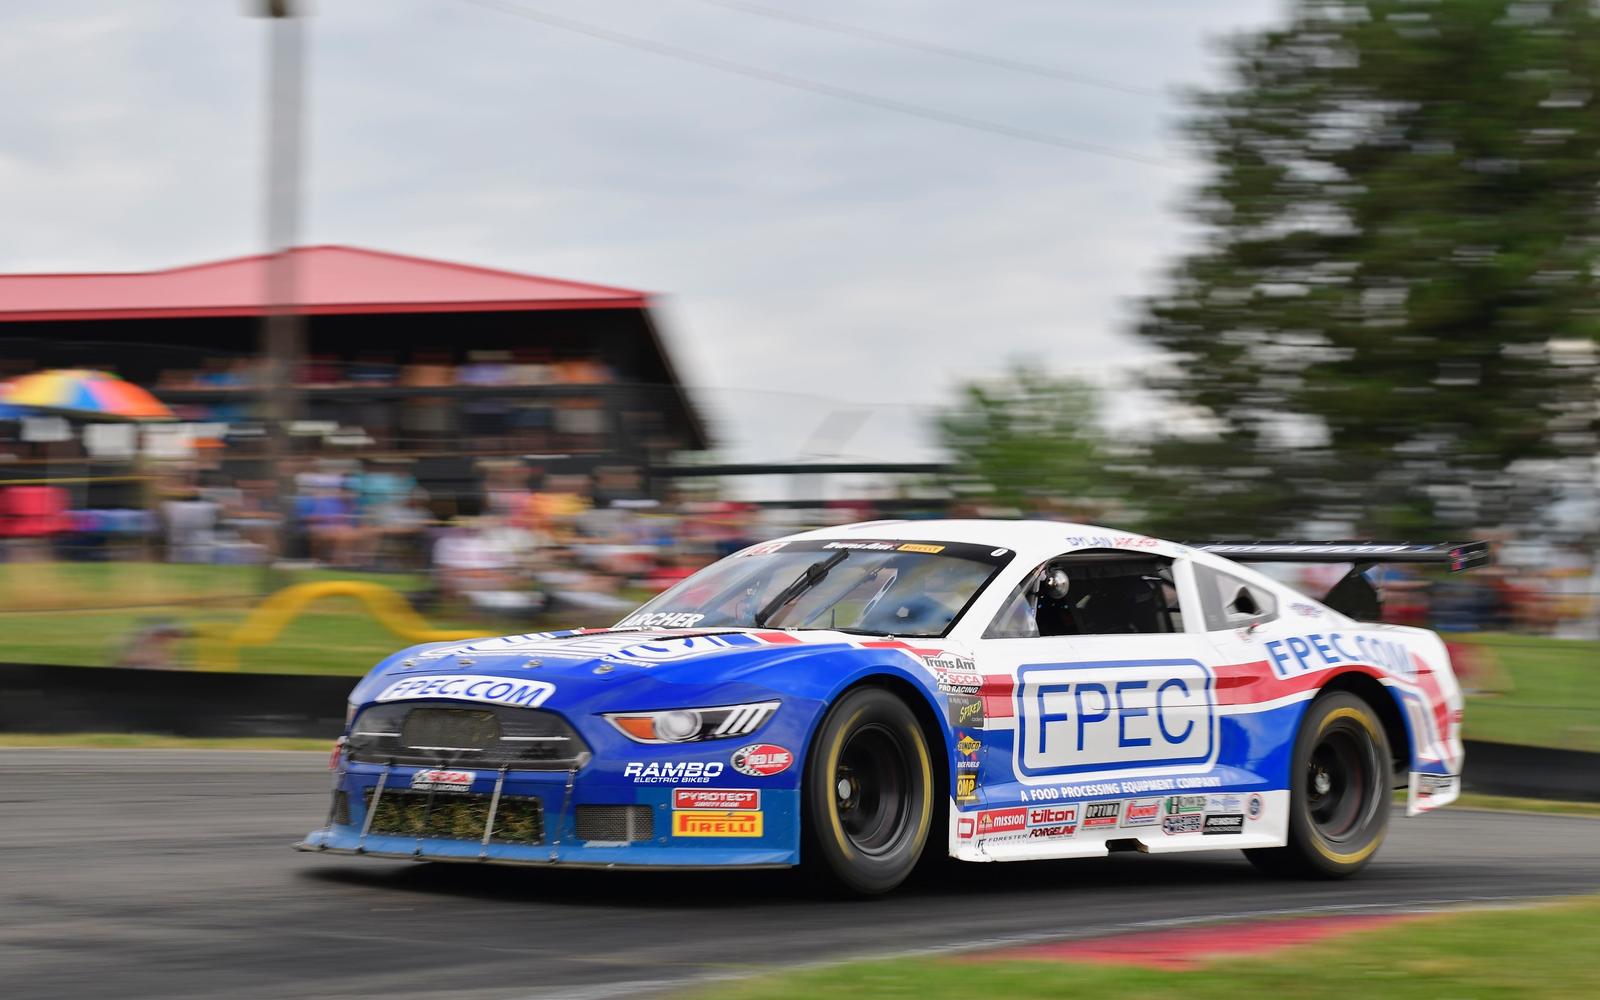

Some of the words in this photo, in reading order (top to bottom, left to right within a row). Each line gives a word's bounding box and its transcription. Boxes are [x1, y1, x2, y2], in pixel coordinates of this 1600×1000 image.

[922, 656, 955, 669] Trans
[955, 658, 976, 670] Am
[948, 674, 981, 685] SCCA
[386, 679, 545, 706] FPEC.COM
[951, 686, 979, 694] RACING
[1037, 678, 1195, 754] FPEC
[958, 741, 981, 750] SUNOCO
[623, 762, 724, 777] RAMBO
[957, 779, 976, 796] OMP
[1020, 790, 1029, 802] A
[1031, 788, 1058, 800] FOOD
[1062, 783, 1120, 797] PROCESSING
[1121, 779, 1174, 793] EQUIPMENT
[1176, 777, 1221, 788] COMPANY
[678, 792, 753, 801] PYROTECT
[1031, 809, 1075, 823] tilton
[680, 815, 756, 832] PIRELLI
[988, 833, 1028, 842] FORESTER
[1029, 825, 1077, 838] FORGELINE
